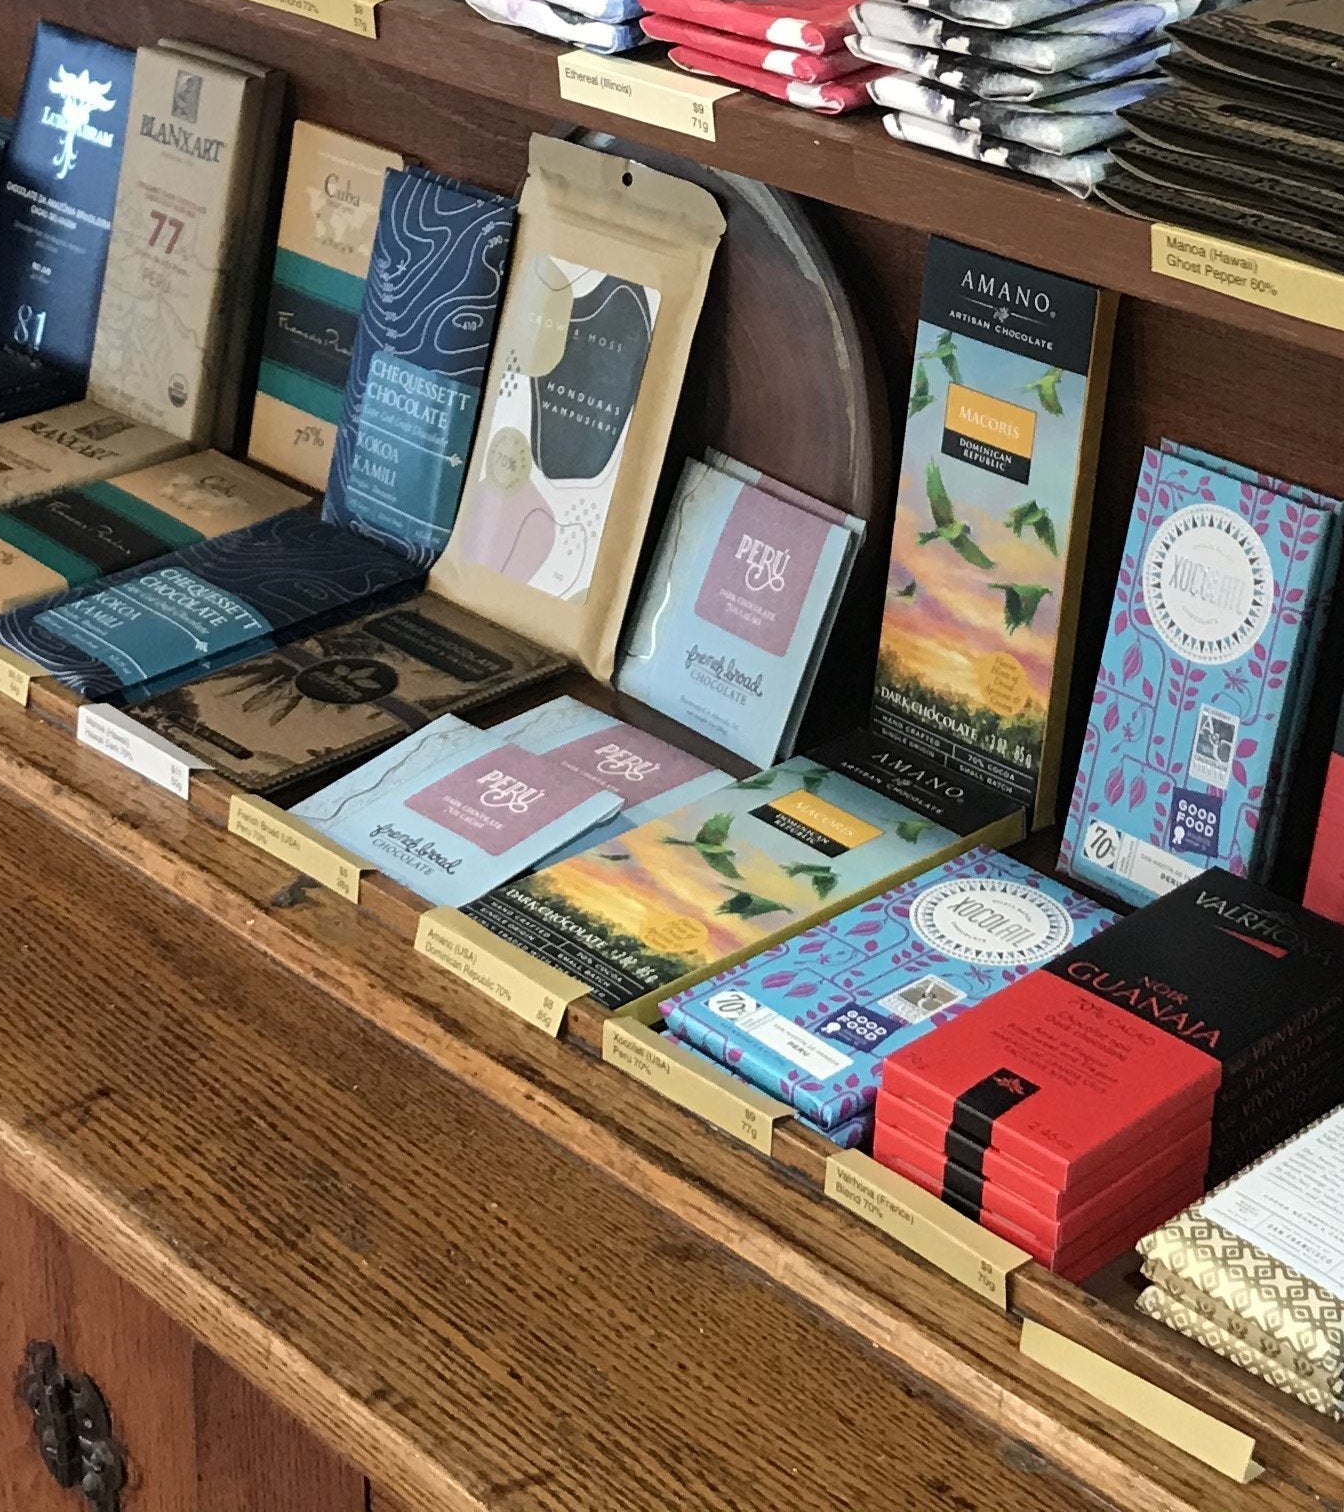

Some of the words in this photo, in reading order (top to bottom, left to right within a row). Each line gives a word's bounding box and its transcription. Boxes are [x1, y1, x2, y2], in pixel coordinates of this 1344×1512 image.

[564, 67, 599, 87] Ethereal
[600, 76, 632, 98] (Illinois)
[692, 101, 704, 115] $9
[139, 113, 226, 164] BLANXART
[691, 116, 709, 133] 71g
[323, 173, 361, 207] Cuba
[147, 210, 185, 255] 77
[1167, 235, 1207, 259] Manoa
[1209, 247, 1259, 274] (Hawaii)
[960, 269, 1052, 314] AMANO
[1166, 253, 1201, 276] Ghost
[1204, 264, 1248, 290] Pepper
[1249, 275, 1279, 297] 60%
[948, 309, 992, 330] ARTISAN
[994, 324, 1054, 352] CHOCOLATE
[371, 359, 471, 411] CHEQUESSETT
[546, 380, 622, 418] HONDURAS
[367, 382, 450, 431] CHOCOLATE
[541, 399, 618, 437] WAMPUSIRPI
[292, 425, 325, 450] 75%
[356, 430, 400, 464] KOKOA
[959, 437, 1013, 465] DOMINICAN
[352, 453, 397, 488] KAMILI
[963, 448, 1006, 472] REPUBLIC
[139, 575, 229, 628] CHOCOLATE
[159, 568, 262, 631] CHEQUESSETT
[689, 668, 748, 707] CHOCOLATE
[1175, 811, 1215, 839] FOOD
[1178, 798, 1218, 825] GOOD
[371, 837, 437, 877] CHOCOLATE
[424, 942, 463, 975] Dominican
[462, 963, 494, 993] Republic
[846, 1009, 888, 1037] GOOD
[1066, 960, 1222, 1050] GUANAJA
[836, 1015, 878, 1042] FOOD
[612, 1045, 633, 1066] Peru
[633, 1057, 653, 1077] 70%
[740, 1119, 759, 1139] 77g
[834, 1181, 862, 1207] Blend
[862, 1196, 885, 1220] 70%
[836, 1166, 875, 1201] Valrhona
[875, 1187, 915, 1226] (France)
[977, 1272, 997, 1292] 70g
